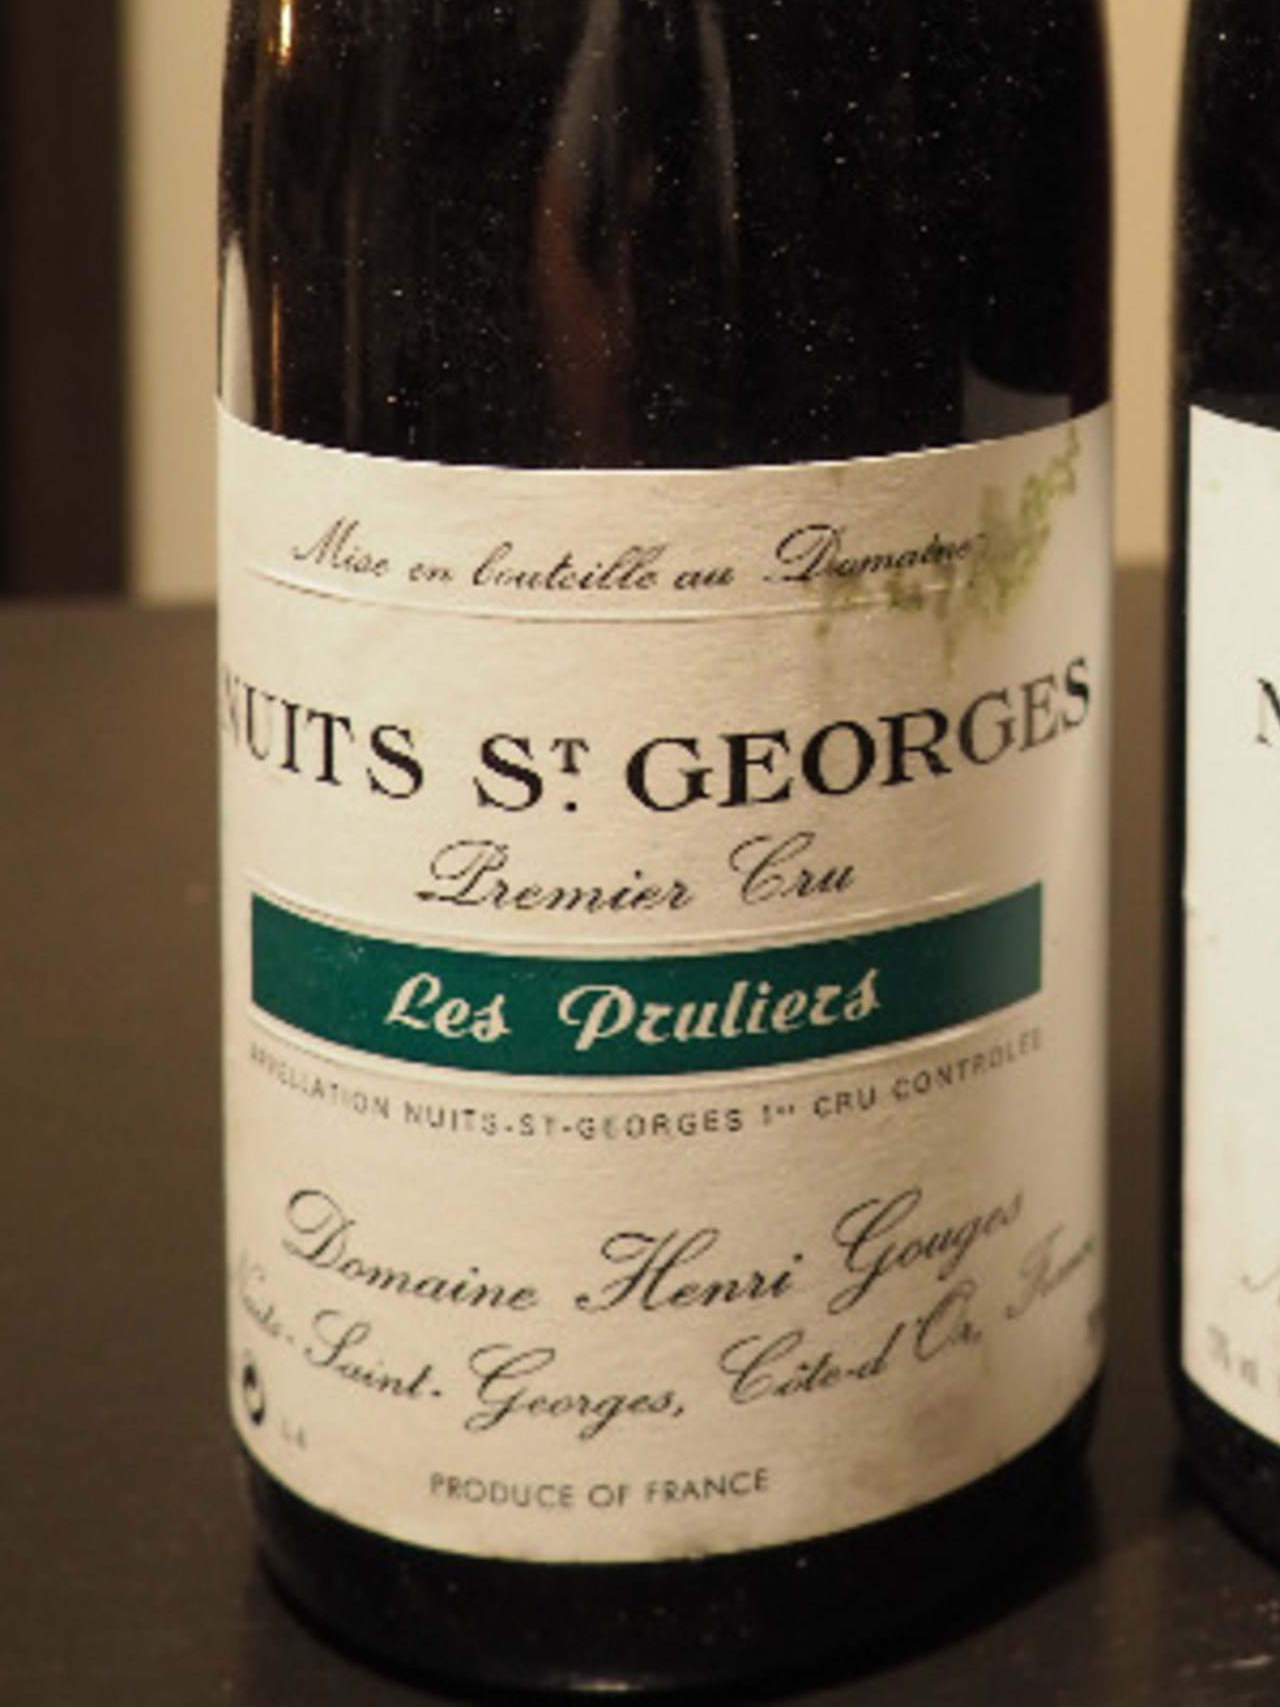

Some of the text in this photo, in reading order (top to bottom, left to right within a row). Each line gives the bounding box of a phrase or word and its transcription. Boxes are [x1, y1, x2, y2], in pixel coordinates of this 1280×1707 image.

[292, 515, 976, 592] Mise en bouteille au Domaine
[625, 655, 1092, 813] GEORGES
[414, 830, 856, 913] Premier Cru
[383, 967, 881, 1052] Les Pruliers
[403, 1099, 744, 1141] NUITS-ST-GEORGES
[812, 1085, 877, 1120] CRU
[281, 1187, 541, 1313] Domaine
[573, 1226, 804, 1314] Henri
[826, 1185, 1027, 1317] Gouges
[429, 1466, 770, 1511] PRODUCE OF FRANCE
